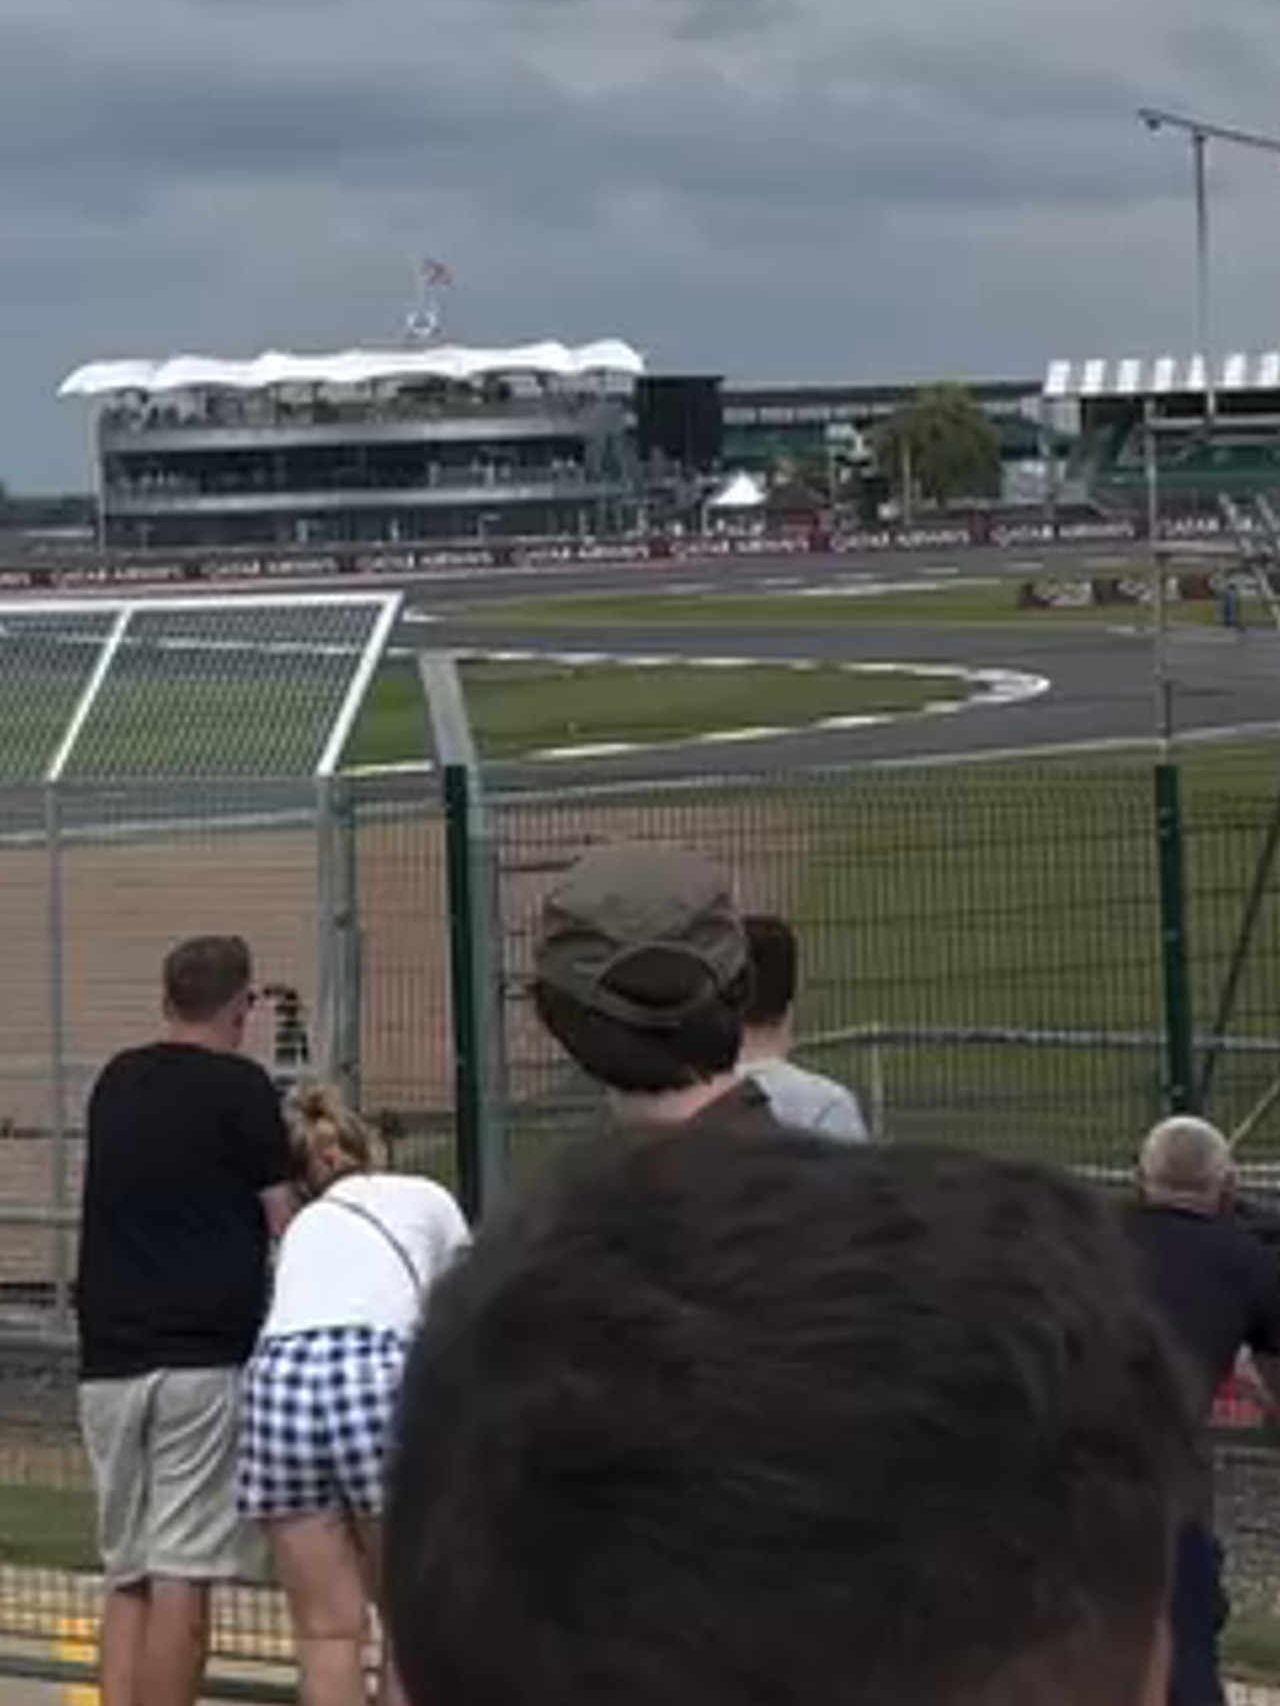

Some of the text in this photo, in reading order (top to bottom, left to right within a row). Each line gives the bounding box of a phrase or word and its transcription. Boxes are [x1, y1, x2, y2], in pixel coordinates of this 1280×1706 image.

[830, 528, 969, 556] QATAR AIRWAYS
[990, 520, 1135, 546] QATAR AIRWAYS
[356, 548, 494, 578] QATAR AIRWAYS
[511, 540, 649, 571] QATAR AIRWAYS
[670, 536, 809, 563] QATAR AIRWAYS
[52, 560, 184, 588] QATAR AIRWAYS
[200, 553, 338, 584] QATAR AIRWAYS
